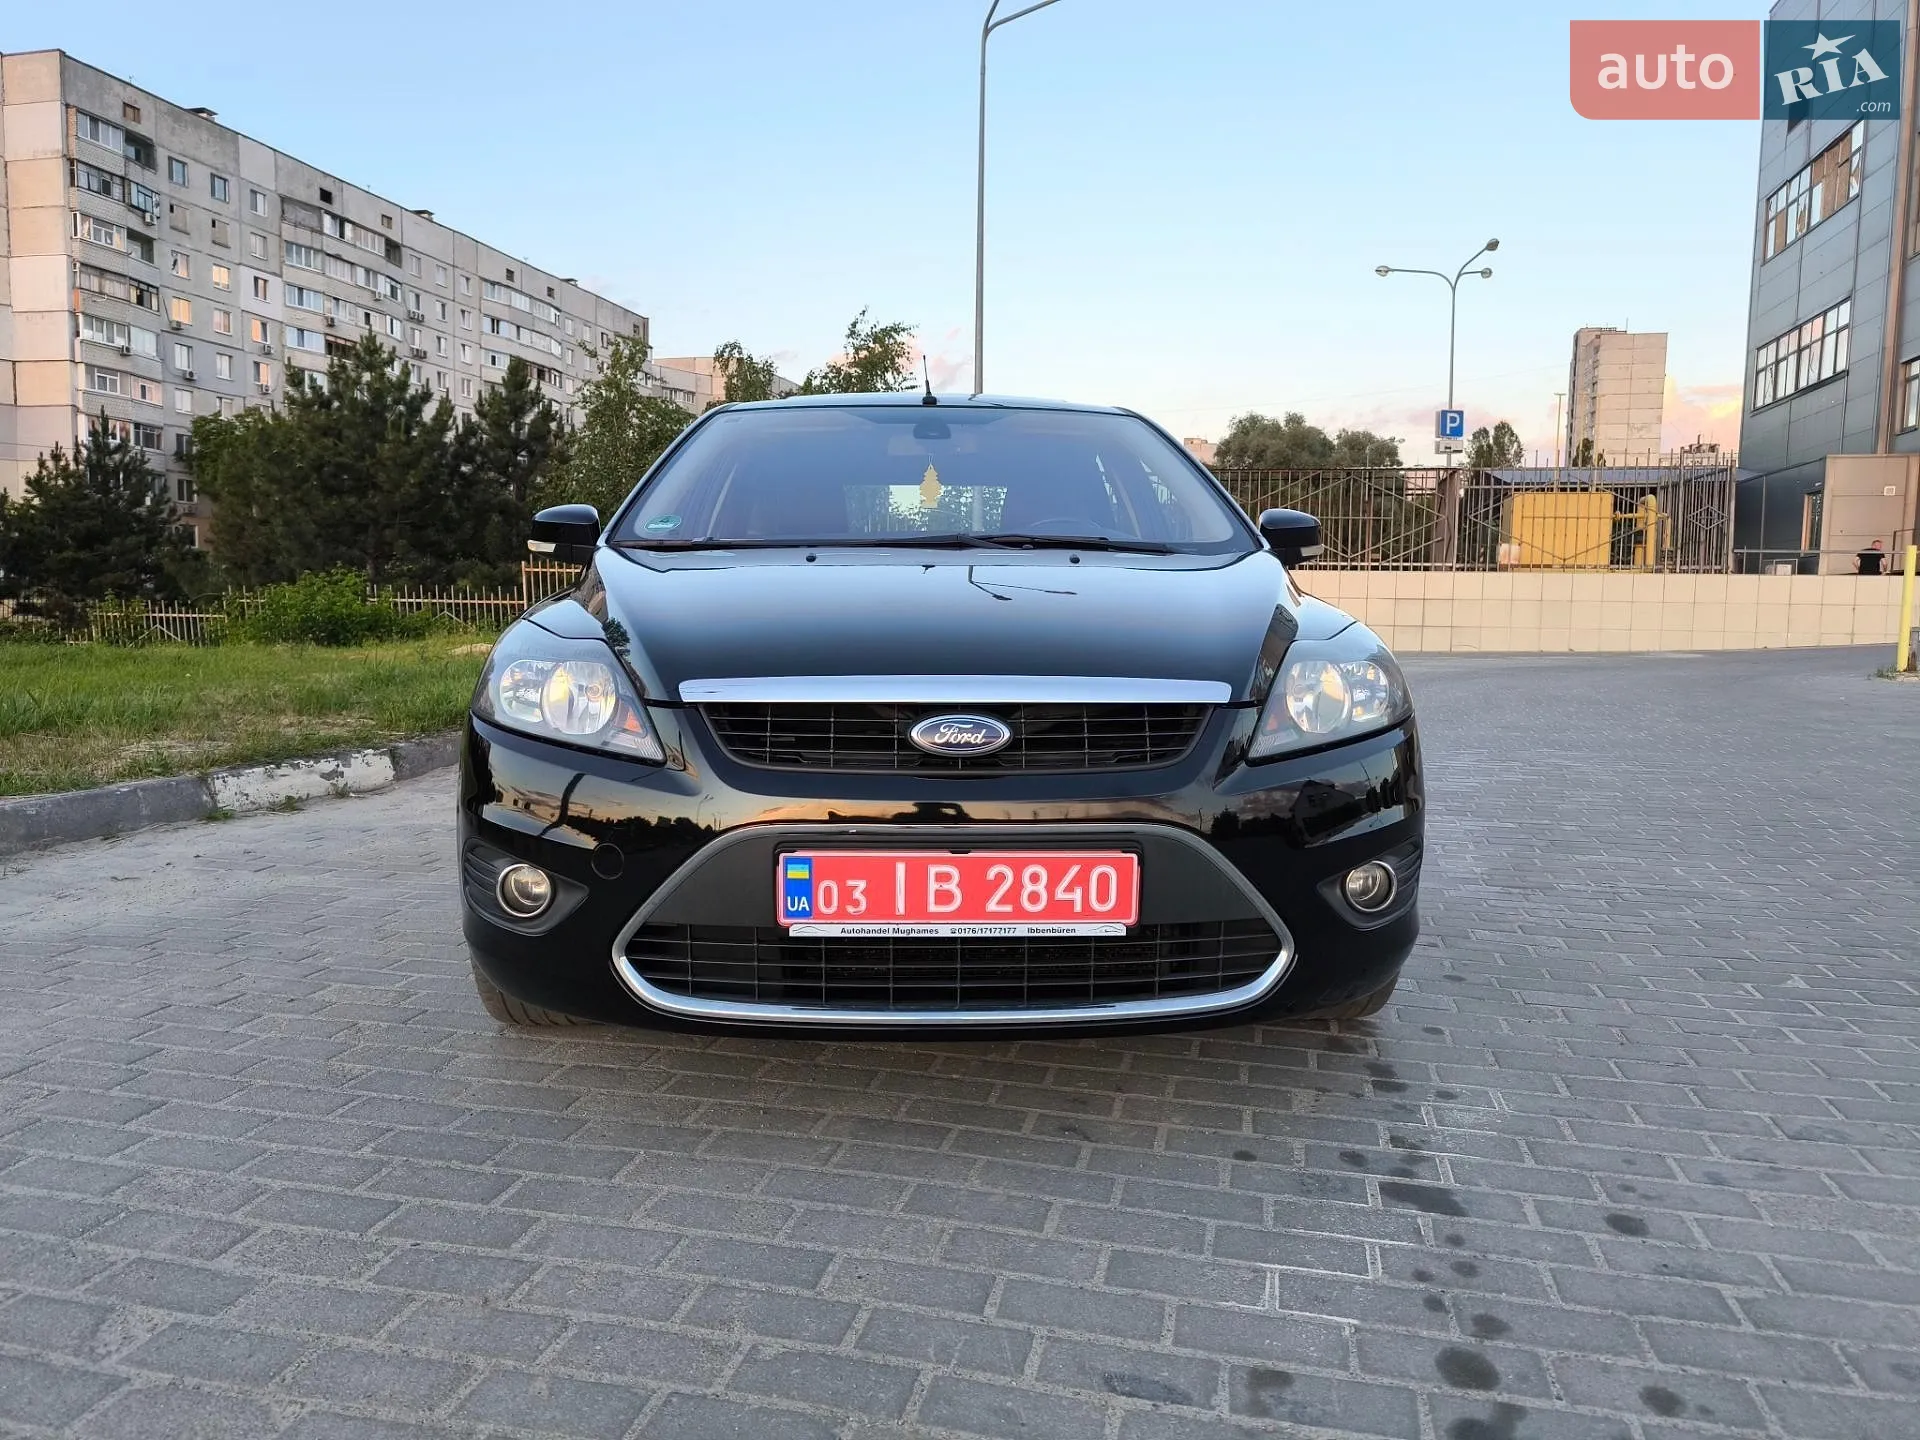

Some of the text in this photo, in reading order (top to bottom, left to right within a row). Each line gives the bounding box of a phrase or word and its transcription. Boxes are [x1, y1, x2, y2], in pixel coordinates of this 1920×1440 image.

[1446, 412, 1460, 435] P
[934, 722, 987, 745] Ford
[817, 861, 1118, 916] 03 IB 2840
[787, 895, 810, 912] UA
[840, 927, 890, 935] Autohandel
[892, 927, 940, 936] Mughames
[1027, 926, 1077, 934] Ibbenbüren
